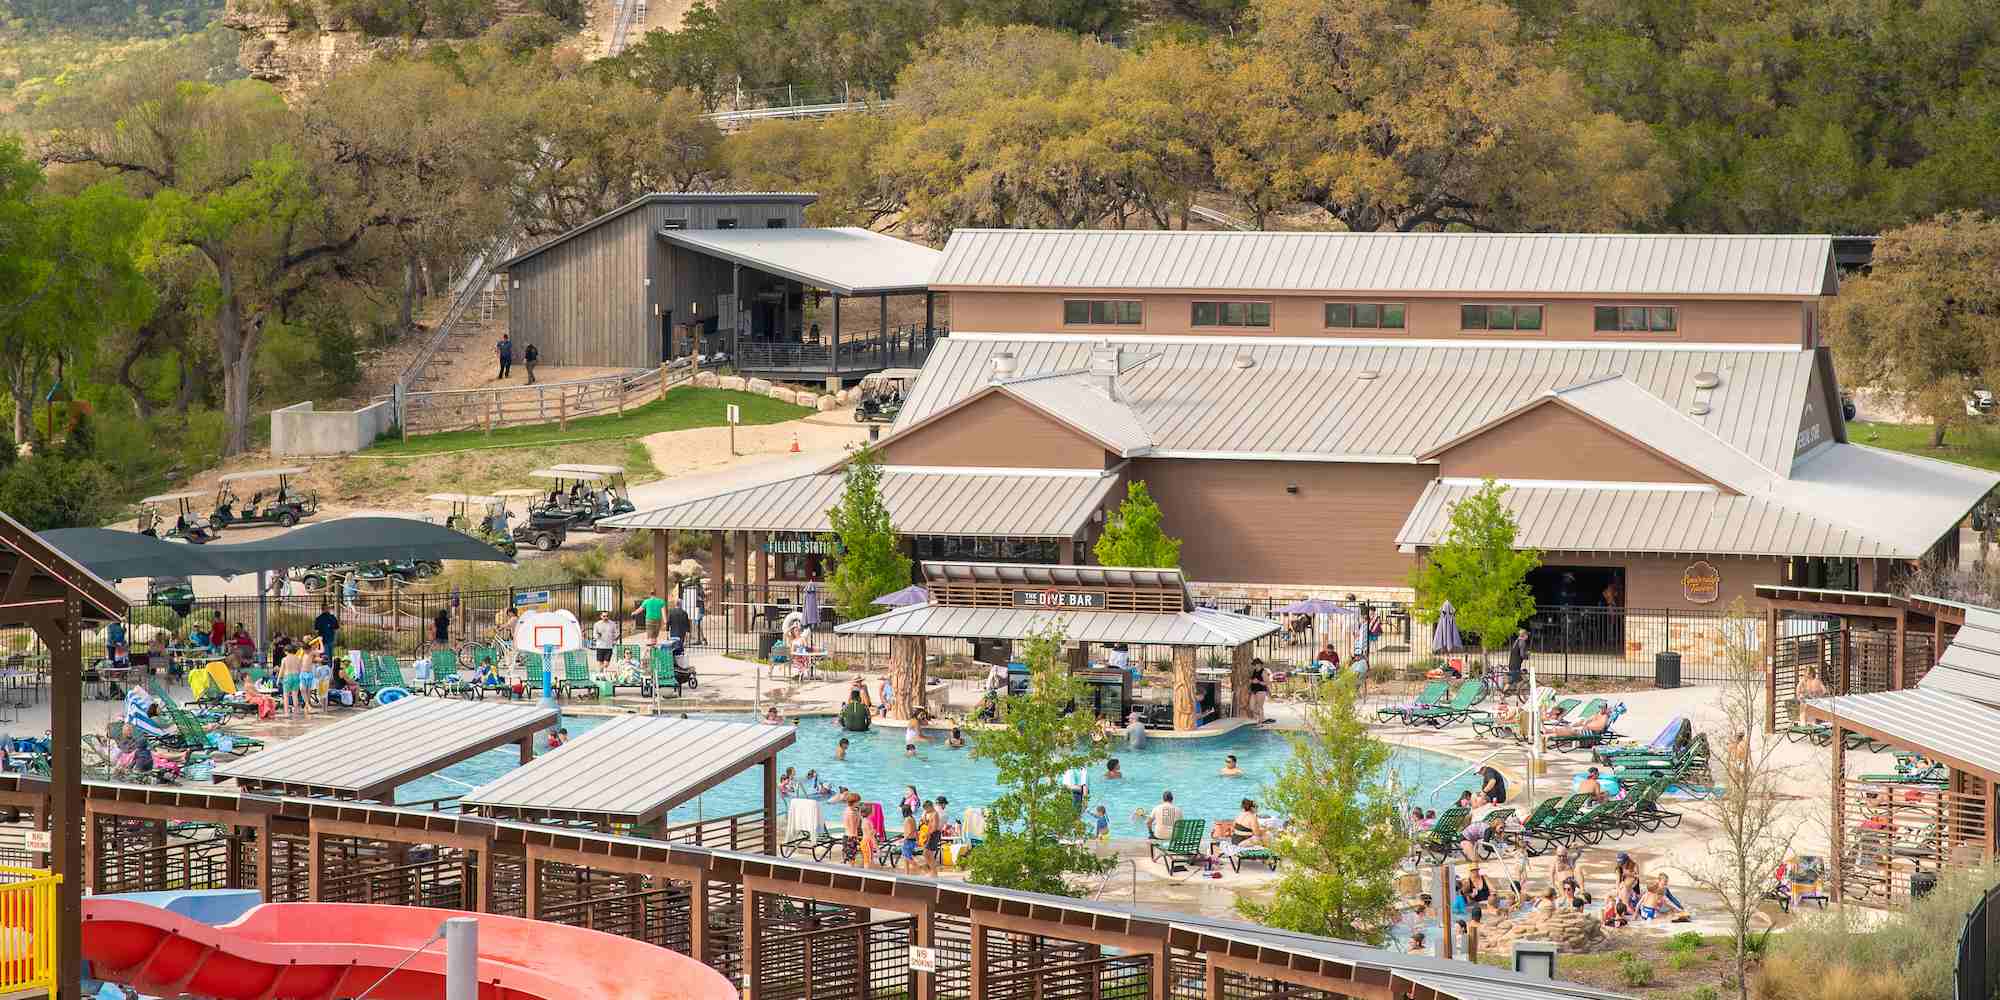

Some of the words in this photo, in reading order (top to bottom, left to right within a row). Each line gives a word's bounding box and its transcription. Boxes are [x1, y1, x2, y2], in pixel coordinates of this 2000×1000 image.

[769, 540, 801, 553] FILLING
[1025, 592, 1038, 600] THE
[1039, 593, 1065, 605] DIVE
[1069, 594, 1092, 606] BAR
